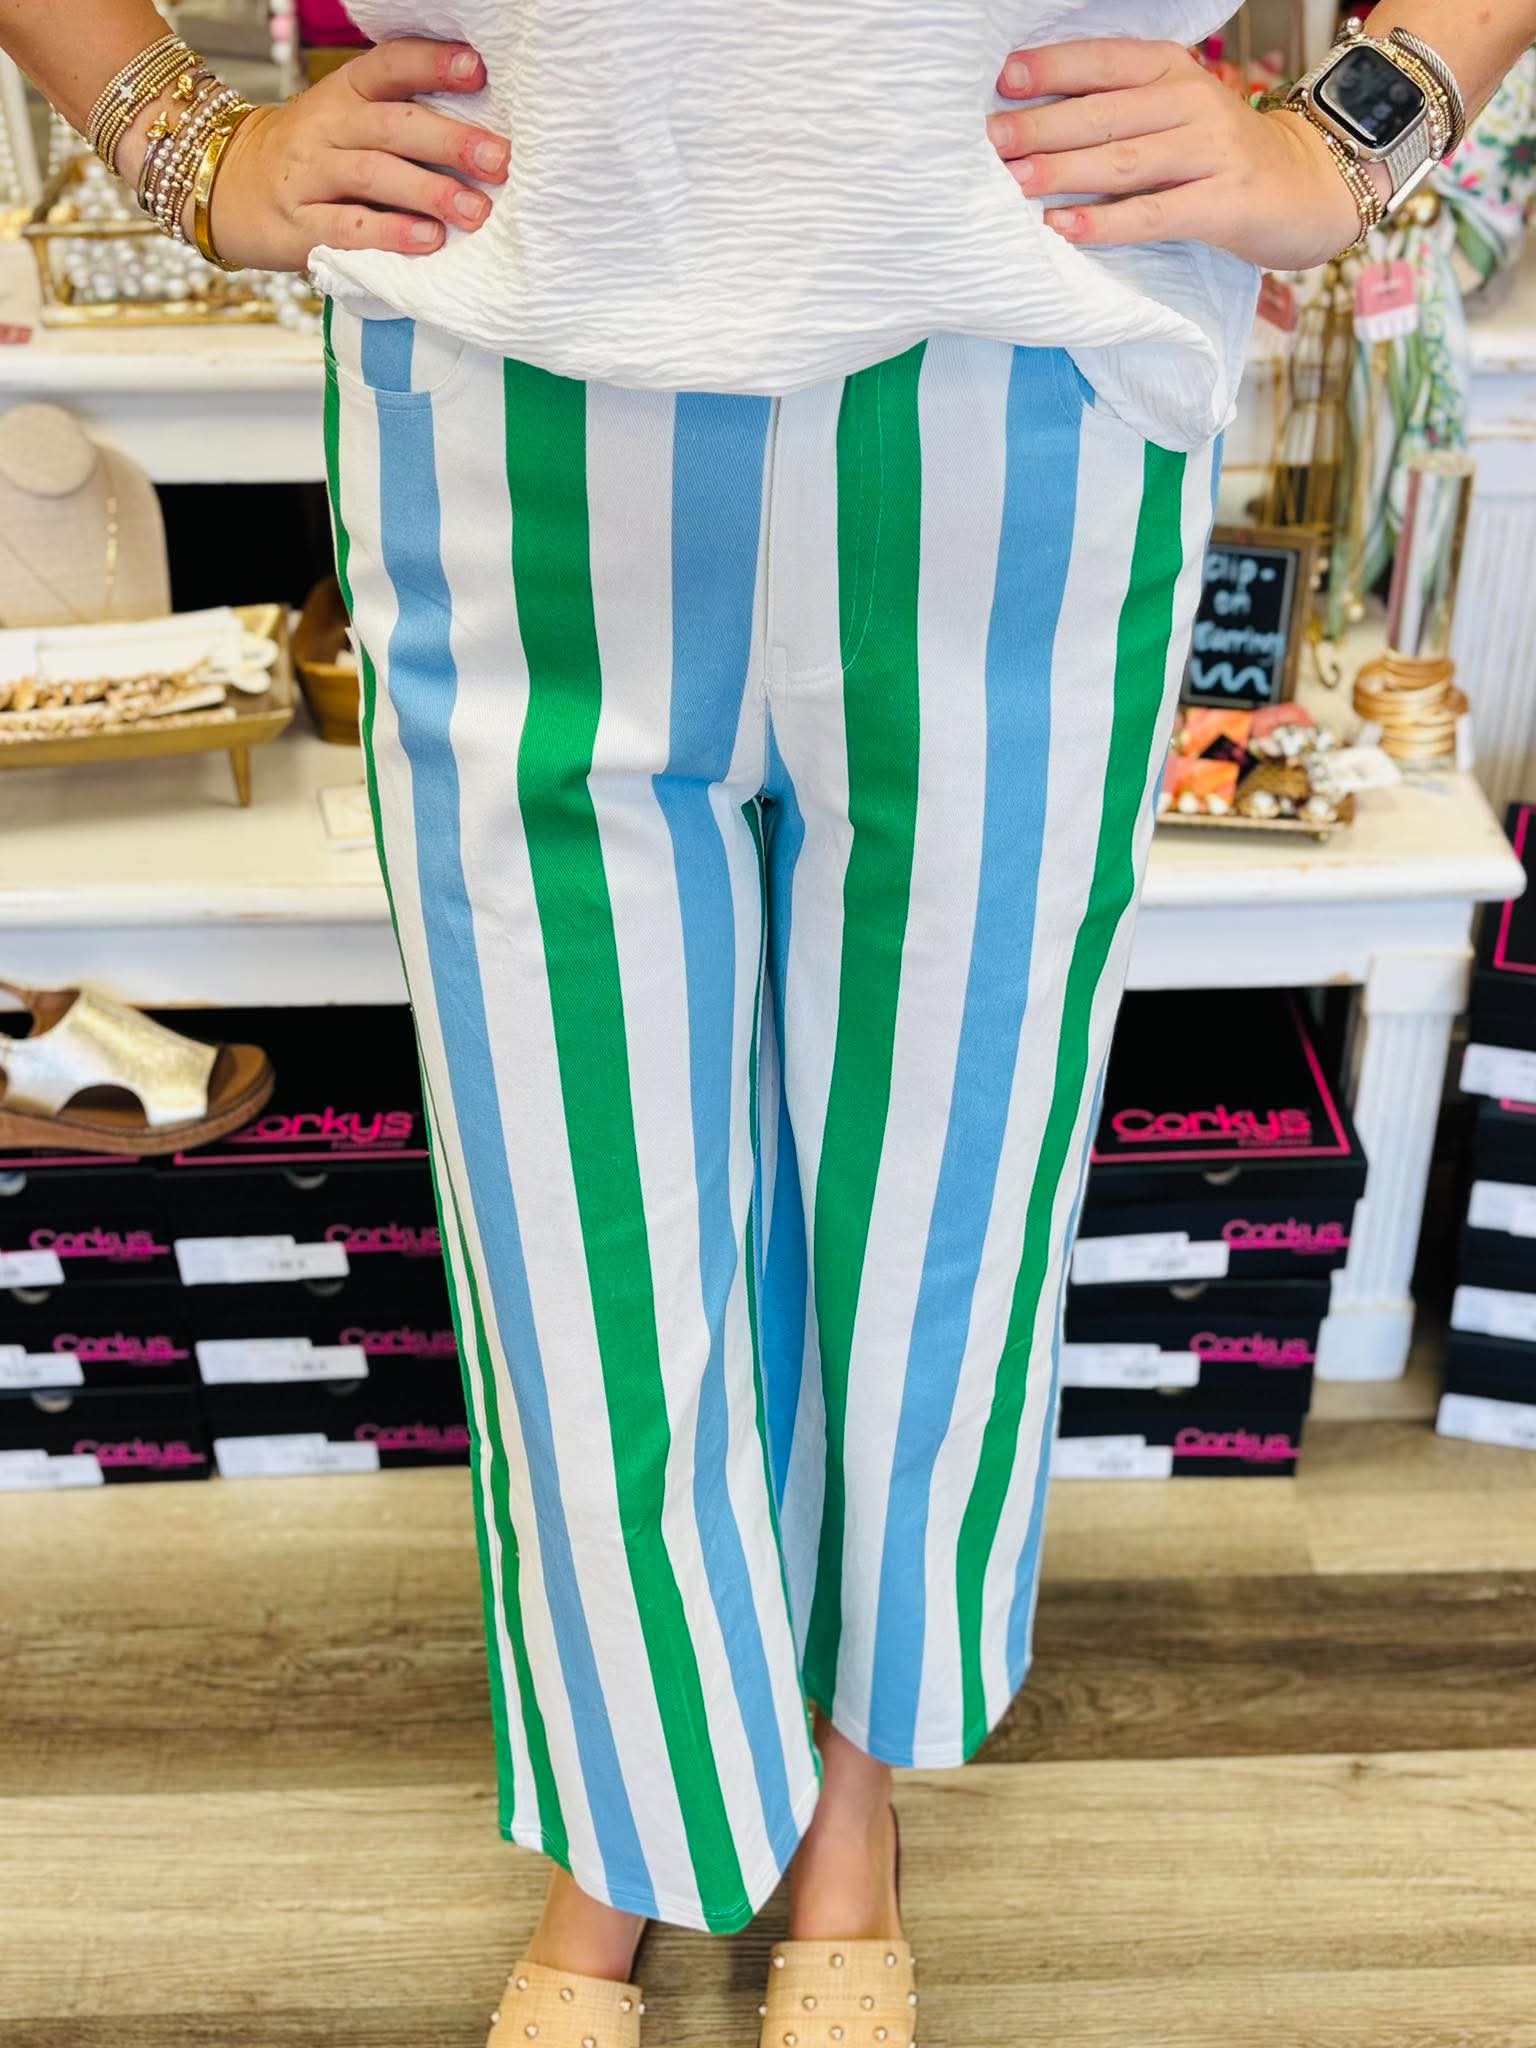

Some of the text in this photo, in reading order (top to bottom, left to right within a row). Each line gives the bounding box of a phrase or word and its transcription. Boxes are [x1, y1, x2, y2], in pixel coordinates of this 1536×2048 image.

[246, 1106, 414, 1143] orkys
[1111, 1103, 1312, 1143] Corkys
[29, 1226, 155, 1258] Corkys
[1222, 1217, 1344, 1250] Corkys
[53, 1331, 174, 1362] Corkys
[1190, 1331, 1310, 1366] Corkys
[1175, 1427, 1291, 1460] Corkys
